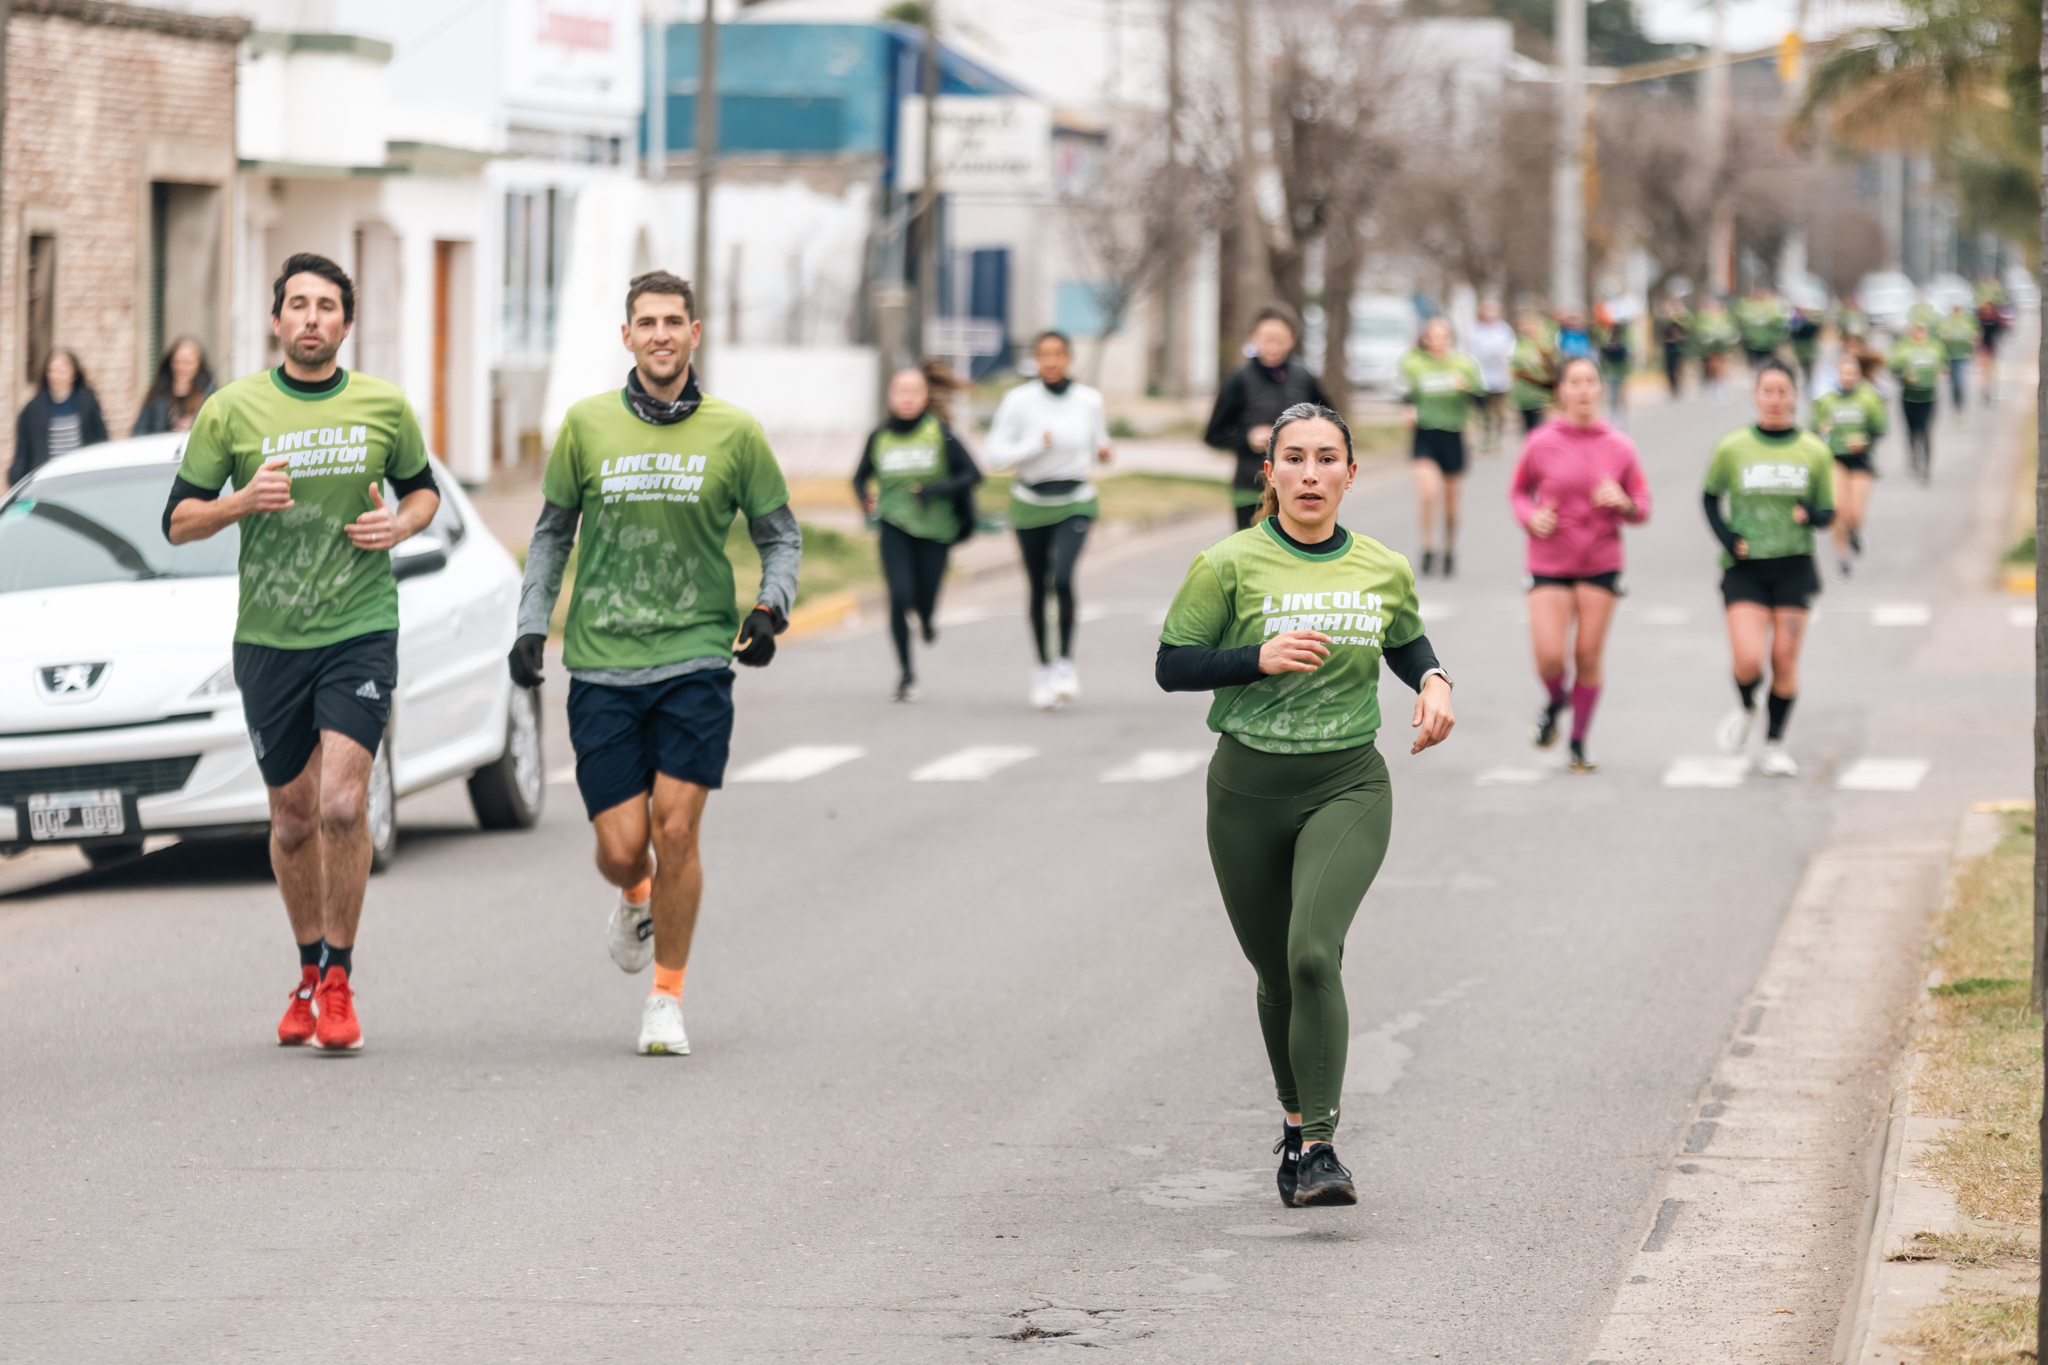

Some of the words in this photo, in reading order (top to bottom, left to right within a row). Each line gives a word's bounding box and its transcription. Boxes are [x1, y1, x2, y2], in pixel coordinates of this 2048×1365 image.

[261, 425, 367, 455] LINCOLN
[290, 462, 366, 480] Aniversario
[600, 452, 707, 477] LINCOLN
[600, 472, 704, 495] MARATÓN
[626, 490, 700, 503] Aniversario
[1262, 590, 1383, 615] LINCOLN
[1263, 611, 1384, 637] MARATÓN
